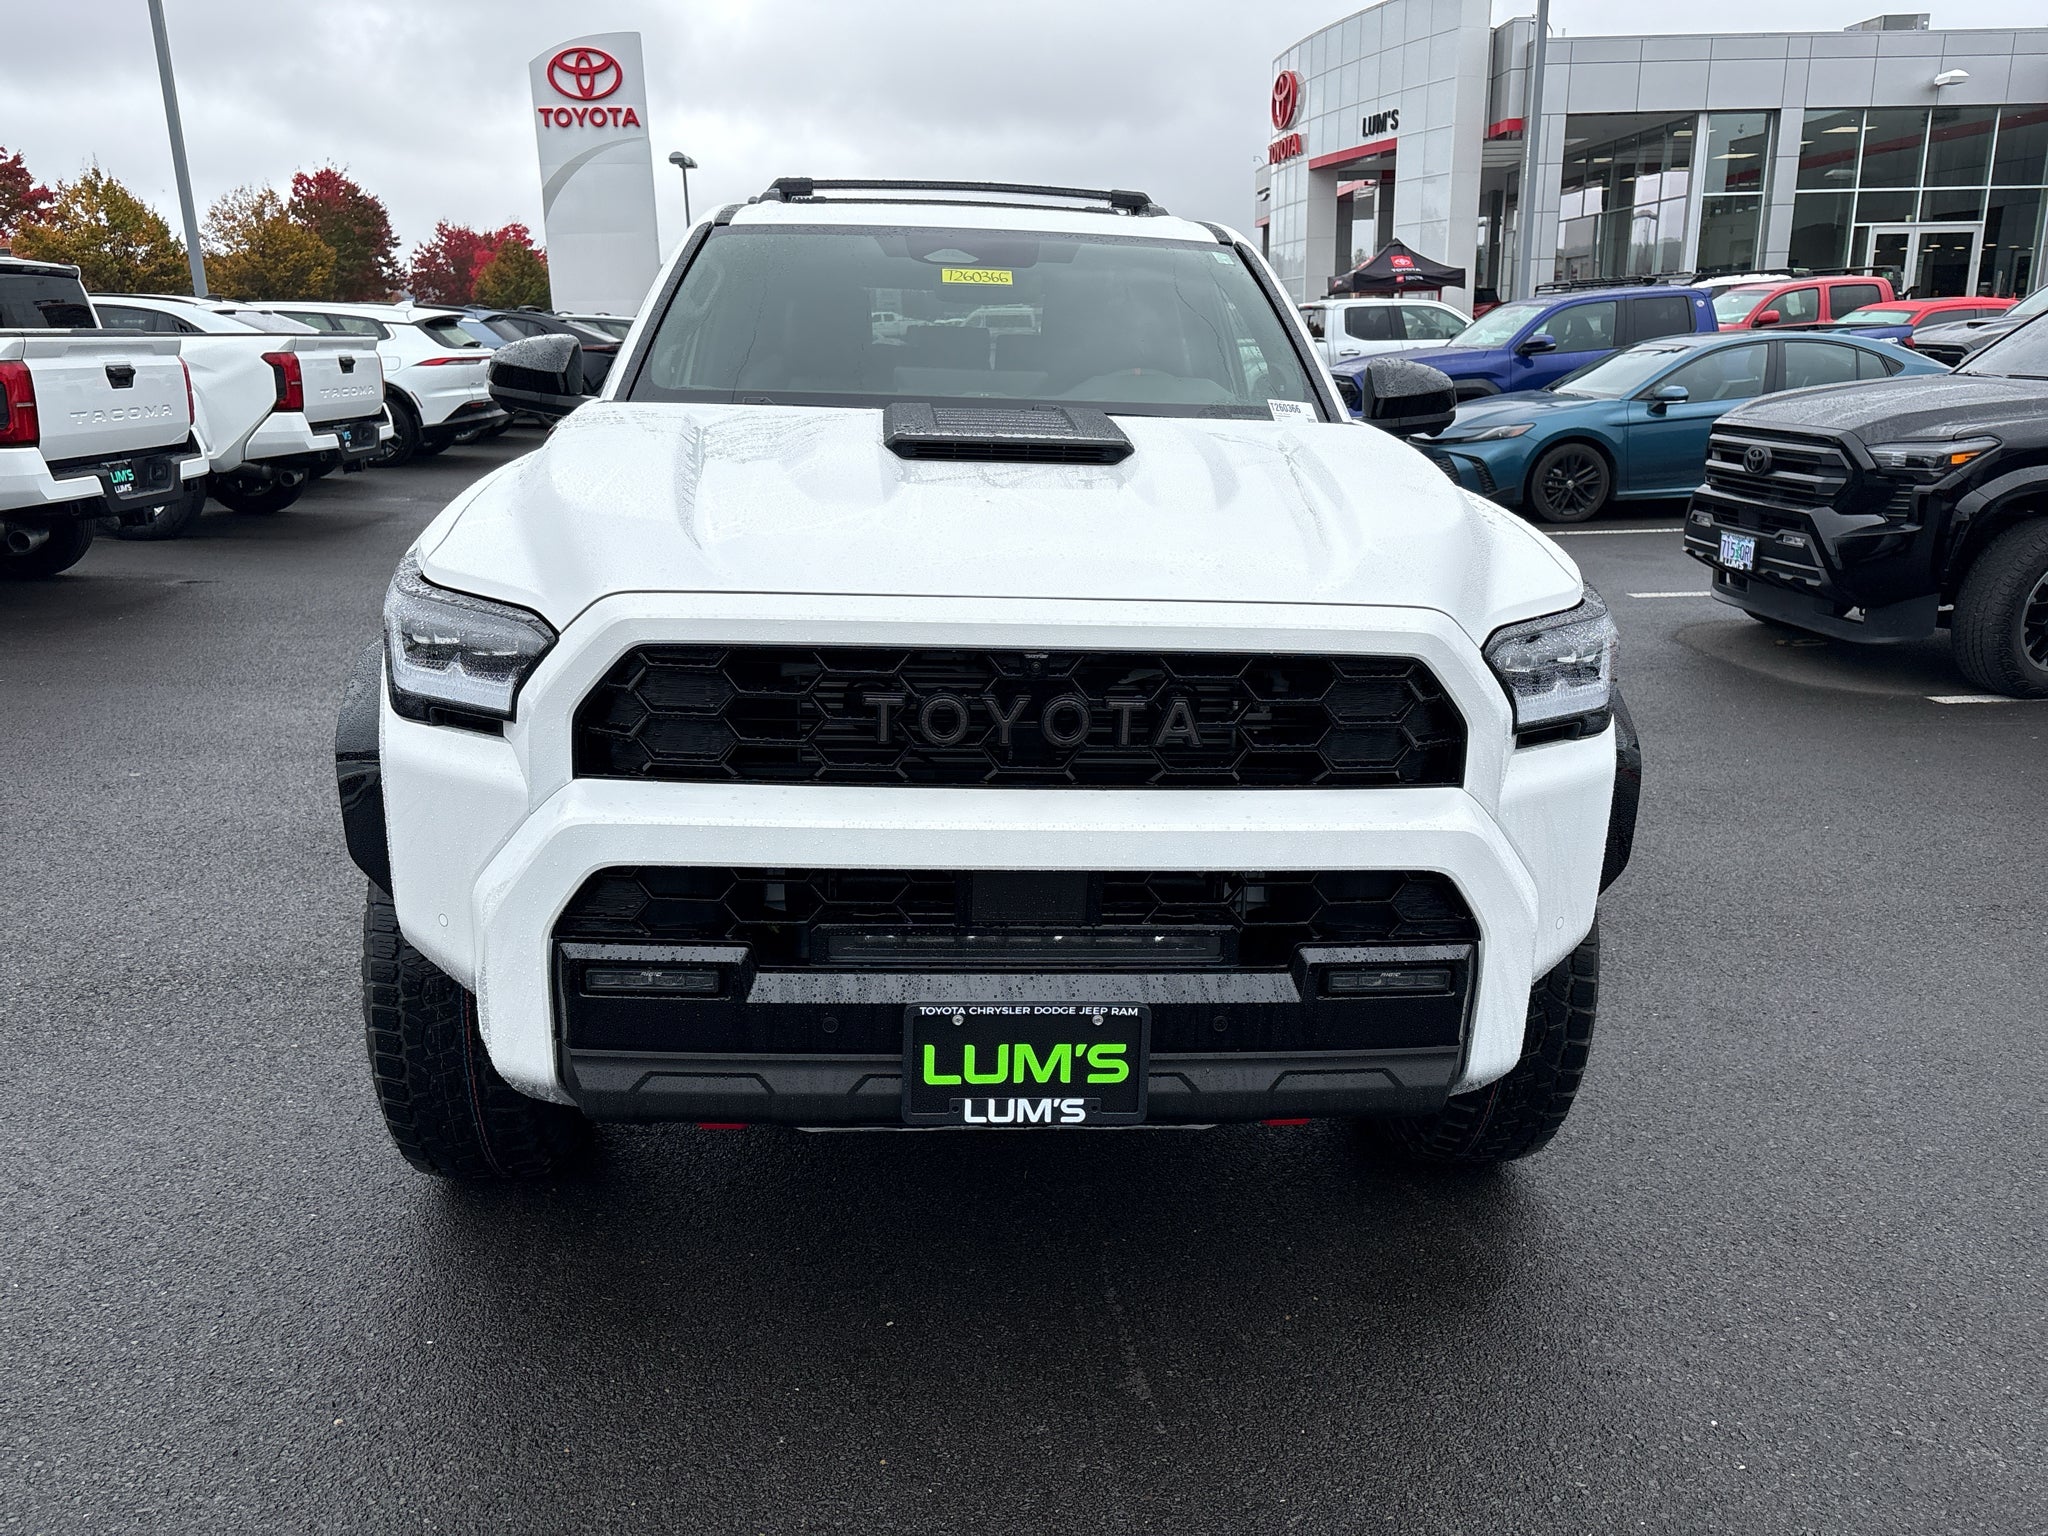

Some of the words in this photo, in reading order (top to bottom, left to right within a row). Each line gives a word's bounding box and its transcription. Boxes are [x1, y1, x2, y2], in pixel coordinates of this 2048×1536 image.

[538, 107, 641, 128] TOYOTA
[1362, 108, 1399, 137] LUM'S
[1268, 133, 1302, 165] TOYOTA
[944, 269, 1009, 283] T260366
[320, 385, 375, 399] TACOMA
[69, 404, 173, 425] TACOMA
[1270, 402, 1301, 414] T260366
[861, 693, 1204, 748] TOYOTA
[920, 1006, 966, 1016] TOYOTA
[969, 1006, 1031, 1016] CHRYSLER
[1034, 1006, 1076, 1015] DODGE
[1078, 1006, 1109, 1016] JEEP
[1111, 1007, 1138, 1016] RAM
[923, 1043, 1130, 1085] LUM'S
[964, 1098, 1086, 1123] LUM'S
